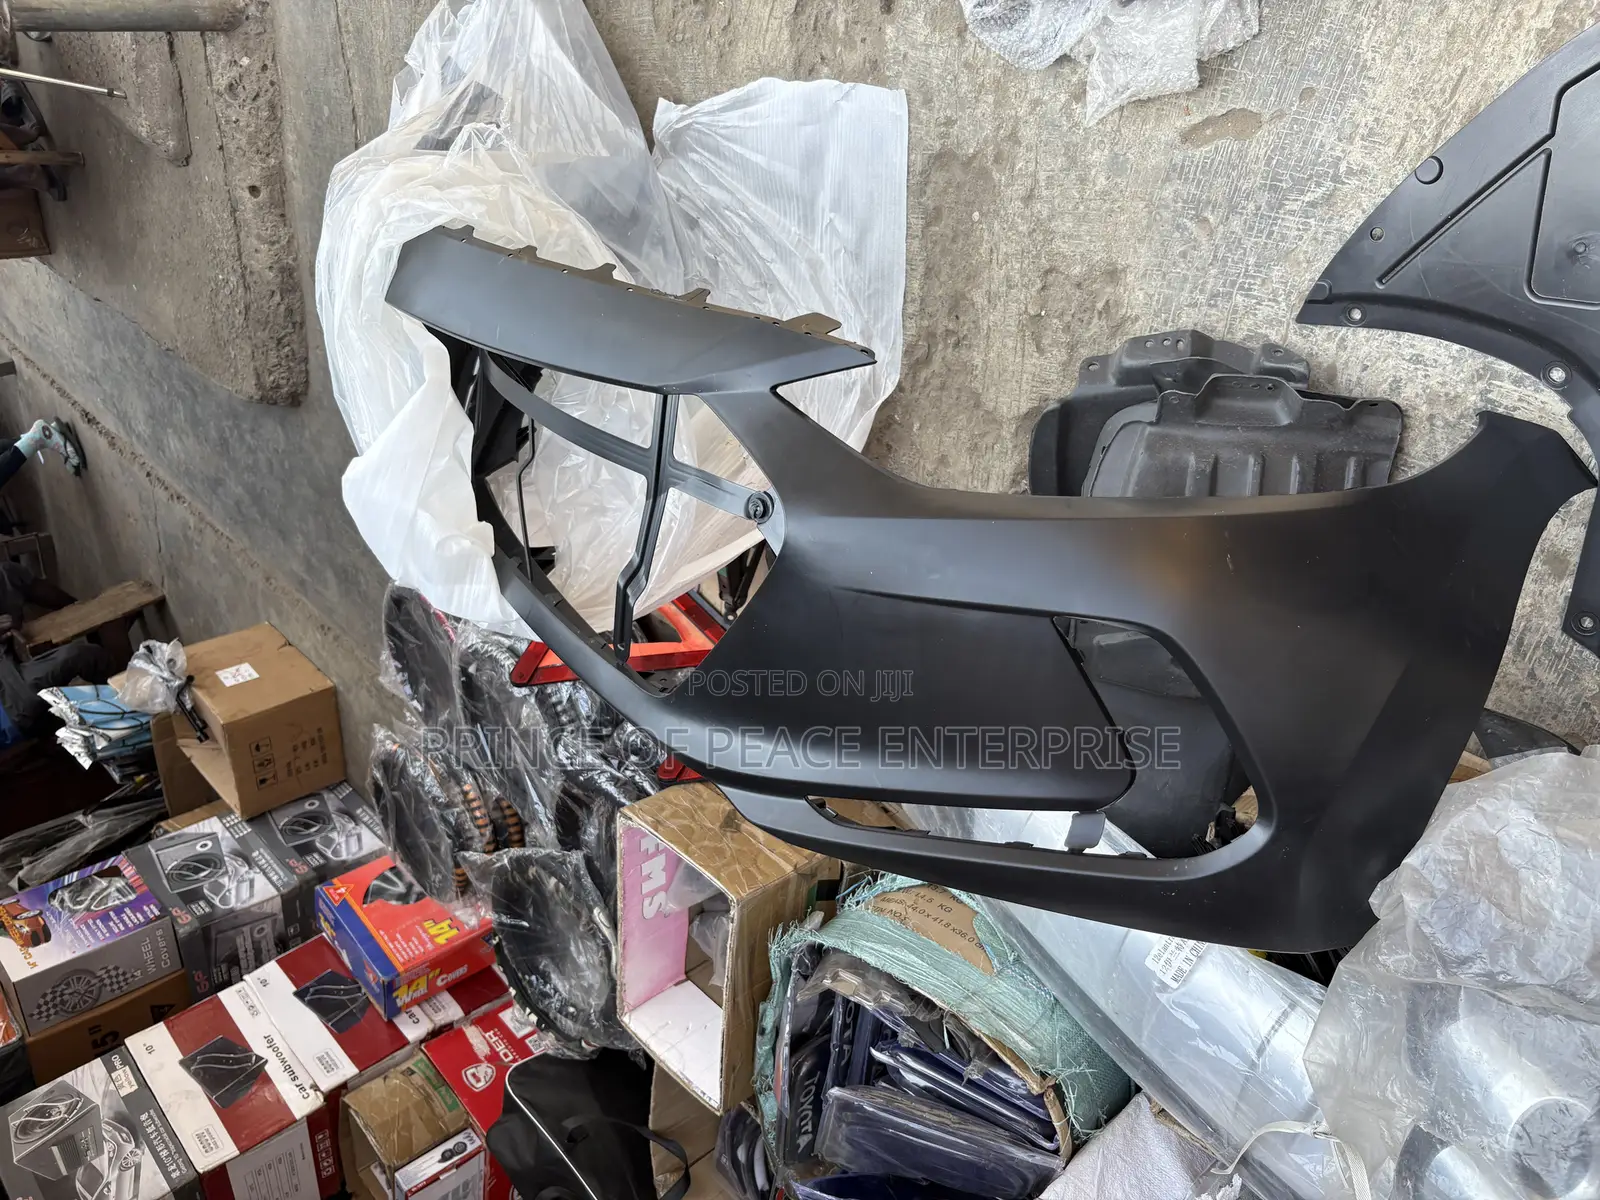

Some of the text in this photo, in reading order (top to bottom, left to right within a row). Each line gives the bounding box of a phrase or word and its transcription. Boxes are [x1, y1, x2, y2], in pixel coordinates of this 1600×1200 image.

[937, 903, 953, 913] KG
[1170, 940, 1206, 984] MADE IN CHIN
[111, 1054, 125, 1070] PRO
[143, 1043, 155, 1055] 10"
[263, 1034, 311, 1100] car subwoofer
[797, 1071, 820, 1153] TOYOTA
